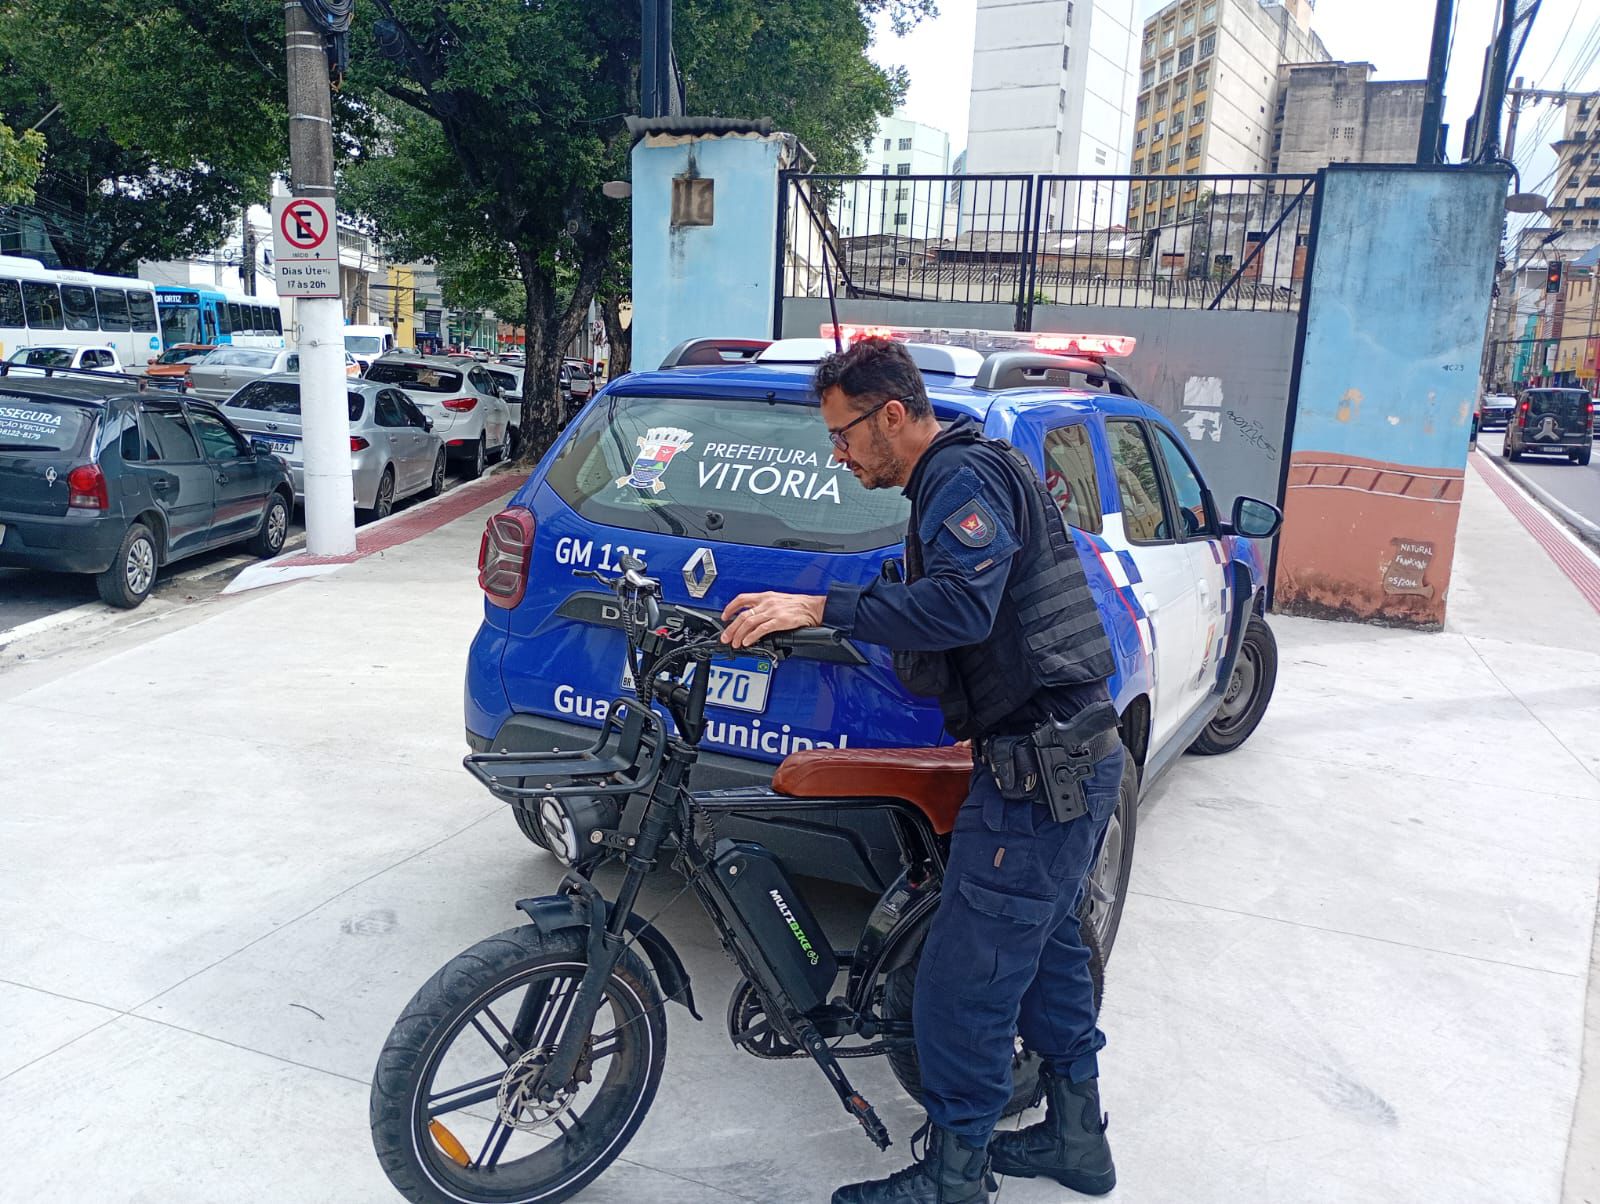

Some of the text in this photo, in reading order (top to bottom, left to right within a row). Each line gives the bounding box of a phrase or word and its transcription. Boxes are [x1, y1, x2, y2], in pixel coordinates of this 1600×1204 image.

[282, 267, 303, 275] Dias
[287, 280, 295, 288] 17
[310, 279, 326, 289] 20h
[19, 423, 56, 435] VEICULAR
[703, 443, 851, 472] PREFEITURA D
[698, 461, 841, 504] VITÓRIA
[555, 537, 594, 567] GM
[769, 889, 812, 952] MULTIBIKE
